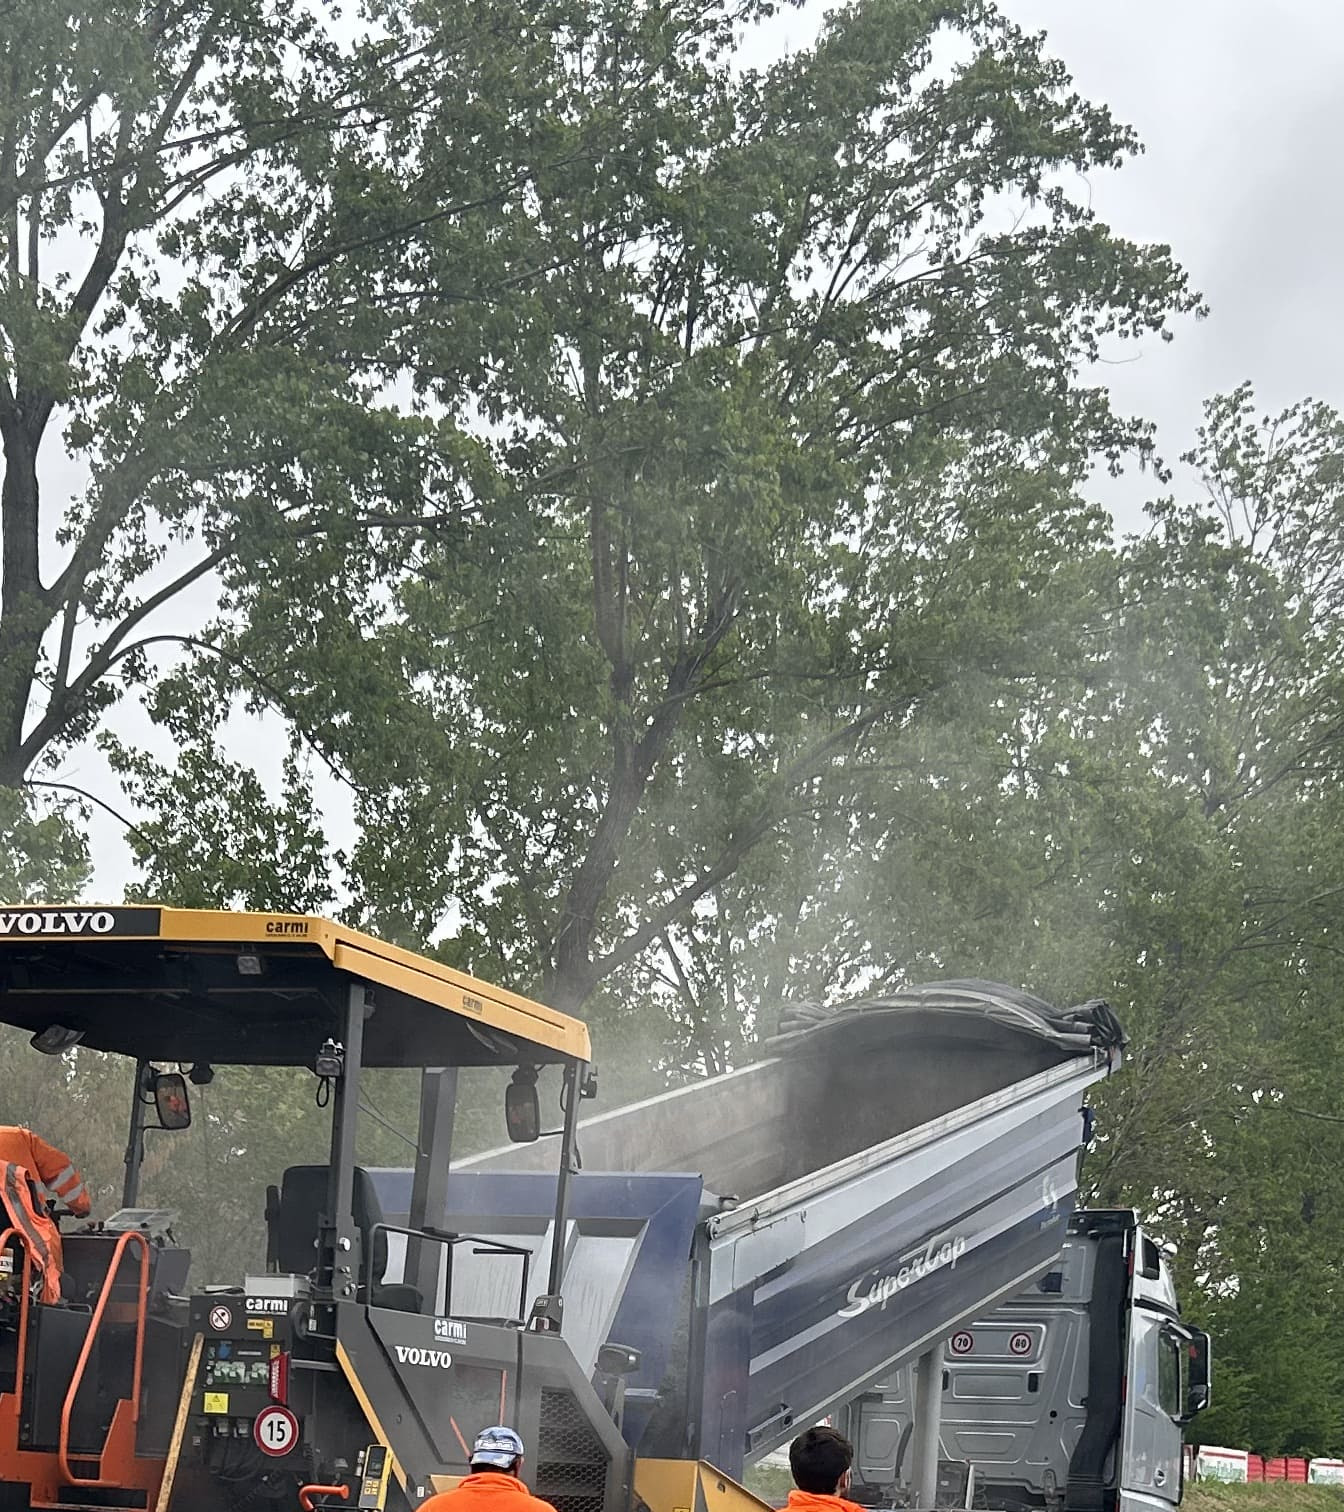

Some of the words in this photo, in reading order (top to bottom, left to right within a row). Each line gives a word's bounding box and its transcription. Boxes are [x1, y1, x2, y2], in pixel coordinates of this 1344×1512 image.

[265, 920, 309, 934] carmi
[462, 994, 483, 1011] carmi
[245, 1298, 288, 1312] carmi
[434, 1319, 468, 1338] carmi
[957, 1337, 969, 1348] 70
[1015, 1337, 1027, 1349] 80
[394, 1345, 452, 1369] VOLVO
[266, 1419, 286, 1443] 15
